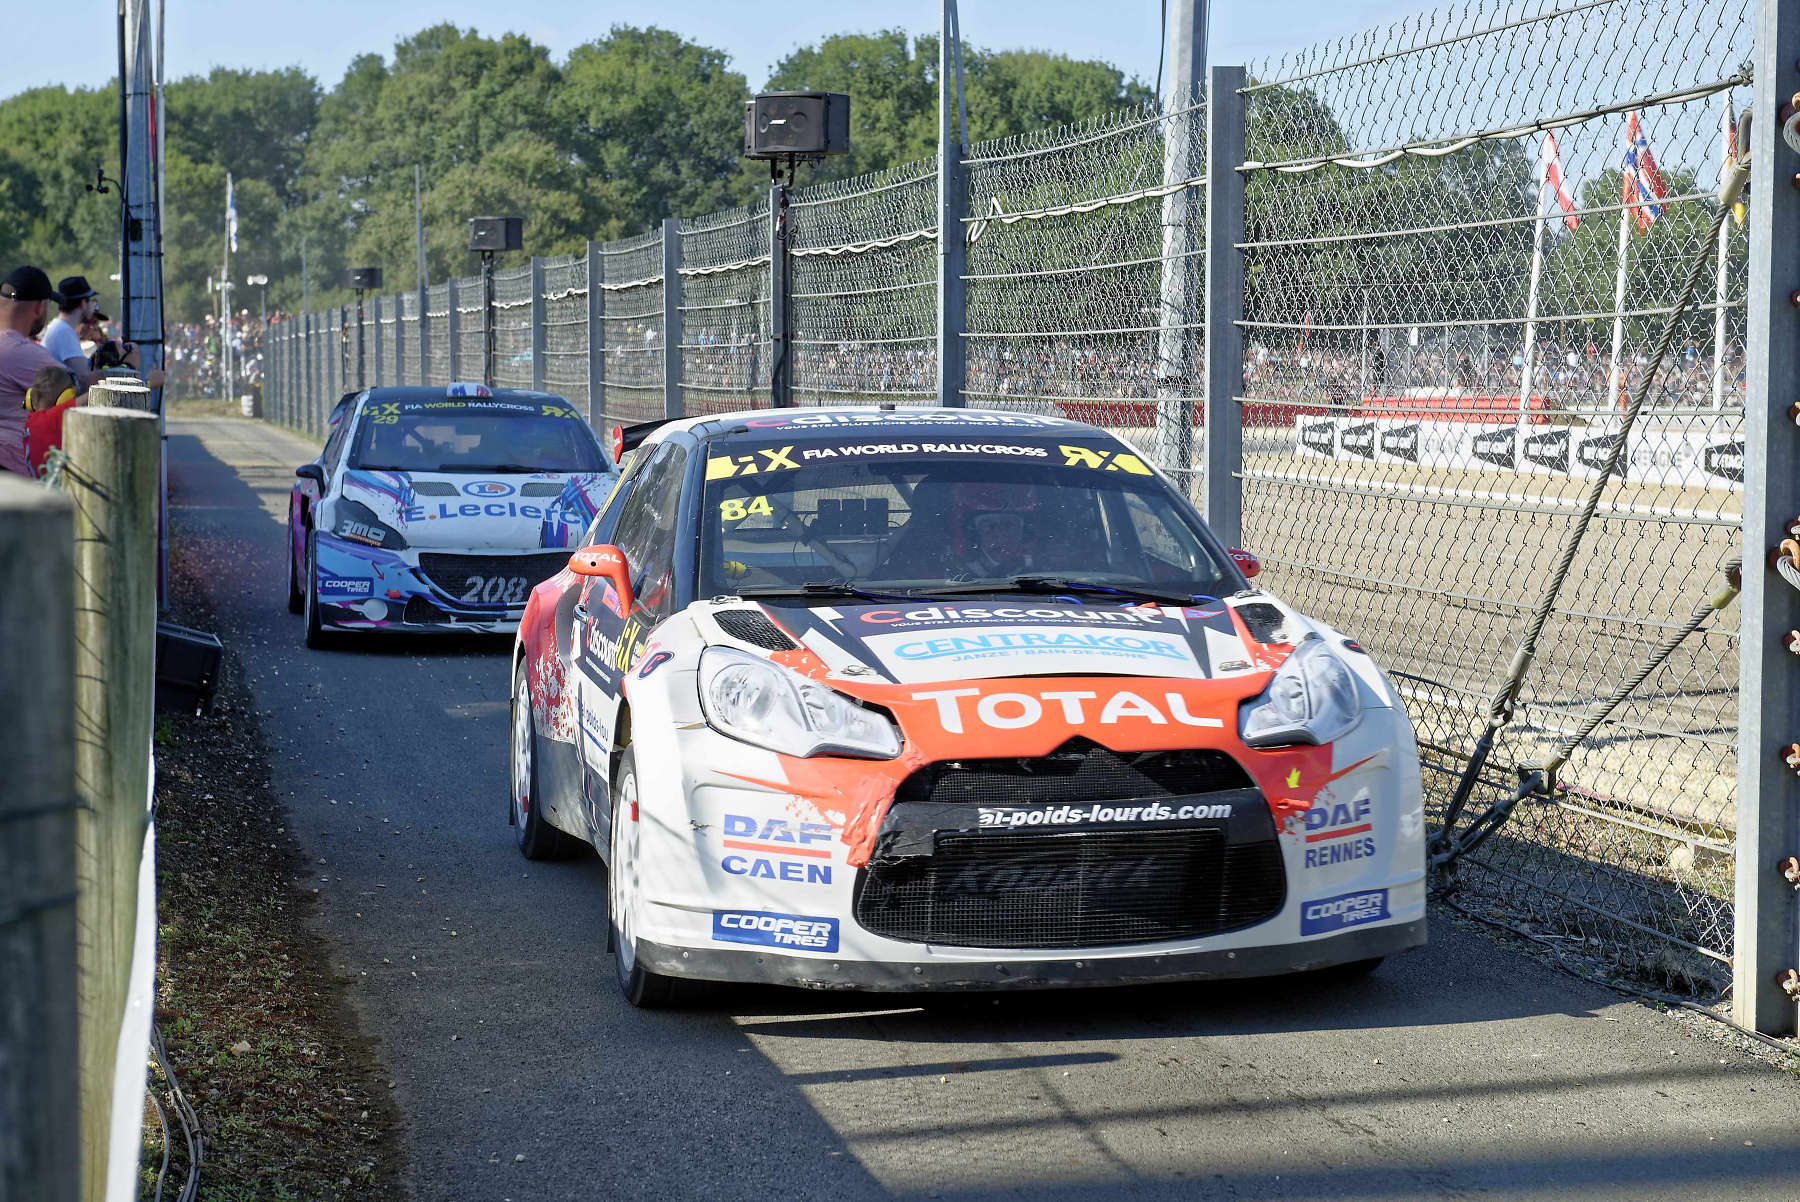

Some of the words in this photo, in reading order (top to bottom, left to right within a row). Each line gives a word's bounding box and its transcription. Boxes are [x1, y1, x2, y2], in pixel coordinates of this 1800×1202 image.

[467, 402, 535, 411] RALLYCROSS
[373, 415, 399, 424] 29
[803, 449, 840, 460] FIA
[840, 444, 919, 455] WORLD
[921, 443, 1049, 457] RALLYCROSS
[405, 502, 581, 525] E.Leclerc
[719, 495, 774, 521] 84
[572, 551, 622, 564] TOTAL
[325, 580, 371, 588] COOPER
[460, 575, 528, 603] 208
[859, 606, 1163, 624] Cdiscount
[893, 632, 1178, 658] CENTRAKOR
[911, 687, 1225, 734] TOTAL
[1305, 798, 1371, 831] DAF
[723, 813, 833, 845] DAF
[1305, 837, 1376, 869] RENNES
[721, 855, 832, 885] CAEN
[1306, 892, 1383, 920] COOPER
[1342, 906, 1381, 923] TIRES
[720, 913, 832, 937] COOPER
[773, 932, 829, 947] TIRES
